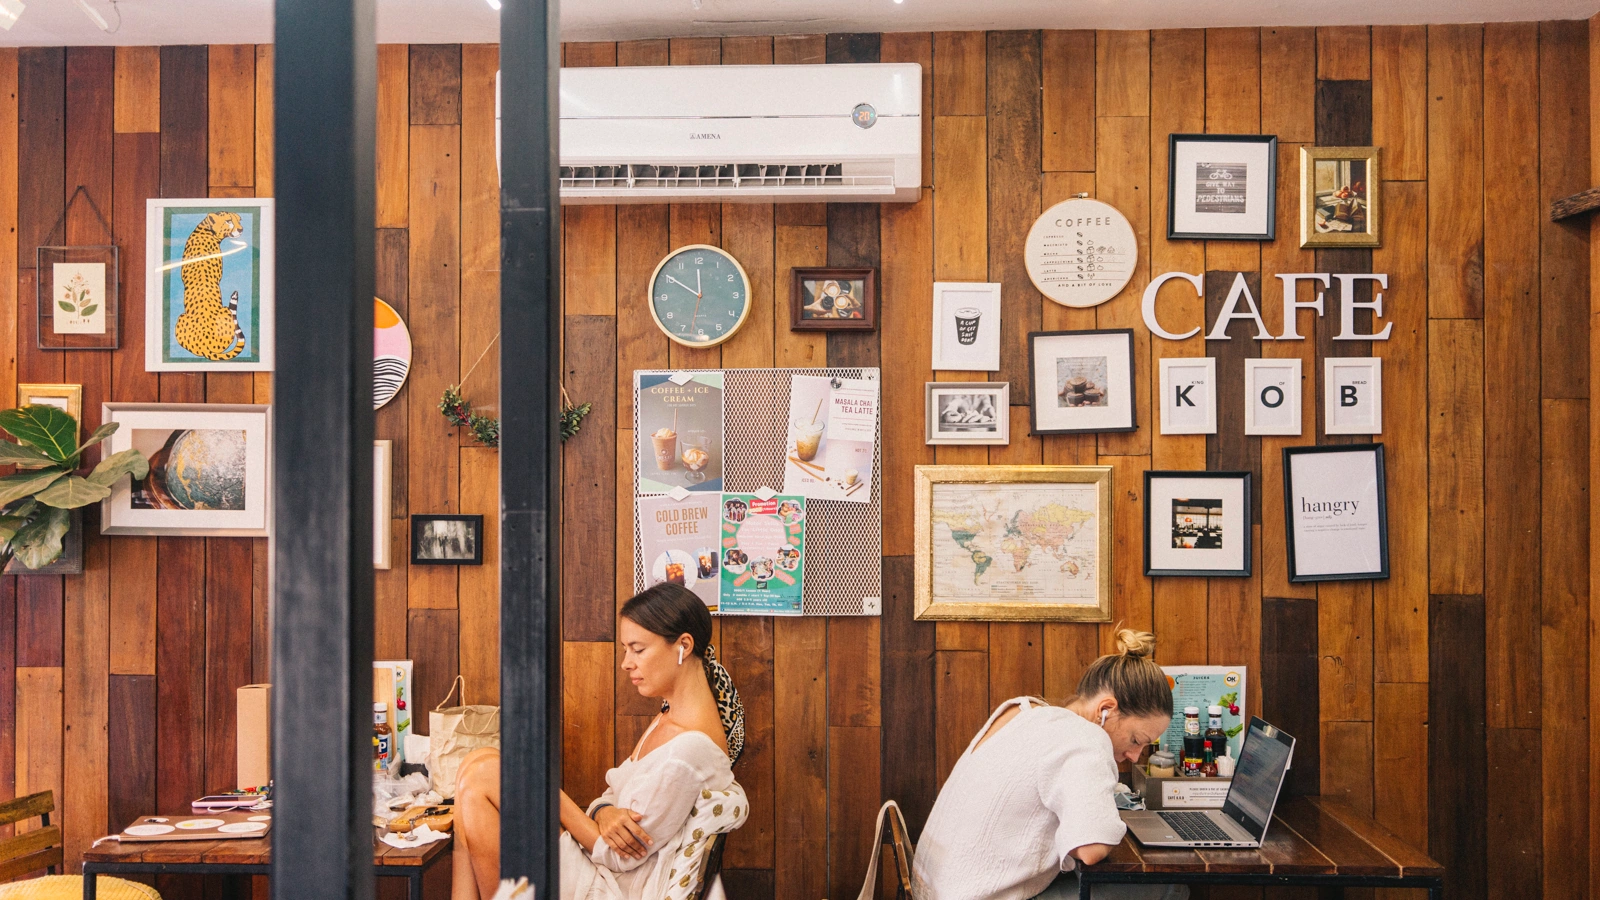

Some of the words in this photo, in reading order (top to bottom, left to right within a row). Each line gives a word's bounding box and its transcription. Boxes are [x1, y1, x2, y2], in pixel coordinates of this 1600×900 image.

[858, 111, 870, 121] 20
[1196, 194, 1244, 203] PEDESTRIANS
[1055, 216, 1110, 227] COFFEE
[1141, 272, 1393, 340] CAFE
[1176, 385, 1196, 407] K
[1260, 386, 1284, 408] O
[1340, 385, 1358, 407] B
[656, 509, 679, 523] COLD
[682, 506, 708, 521] BREW
[1302, 496, 1359, 516] hangry
[666, 521, 698, 536] COFFEE
